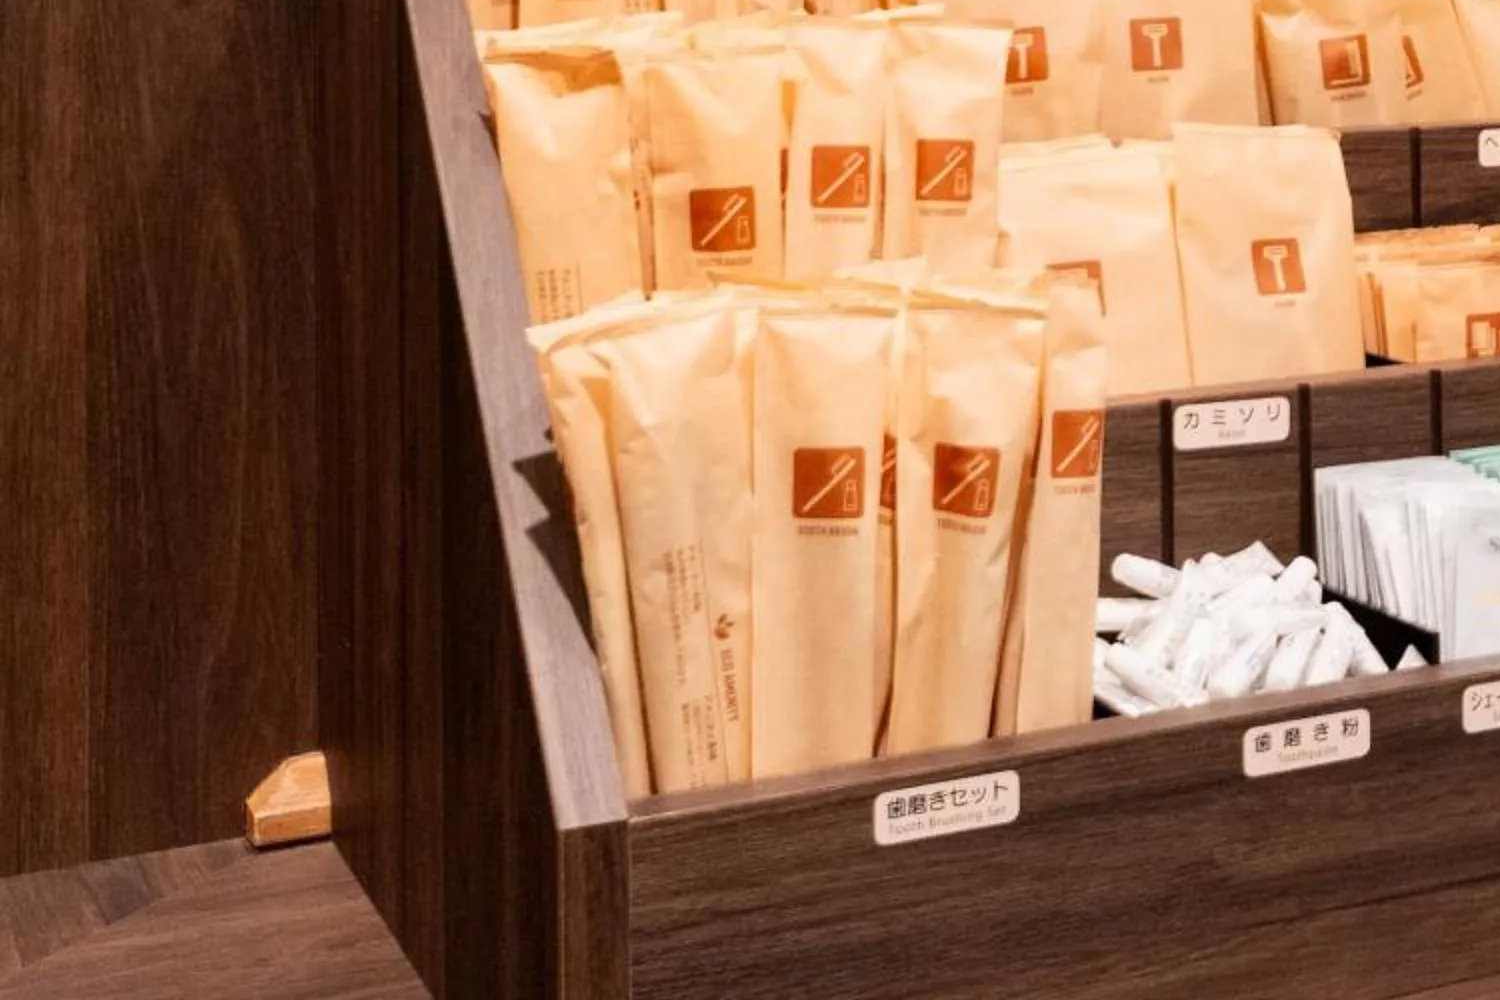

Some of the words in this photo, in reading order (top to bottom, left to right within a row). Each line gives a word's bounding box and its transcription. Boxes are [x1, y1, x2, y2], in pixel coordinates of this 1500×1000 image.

[1183, 403, 1281, 429] カミソリ
[1254, 716, 1359, 752] 歯磨き粉
[886, 780, 1009, 819] 歯磨きセット
